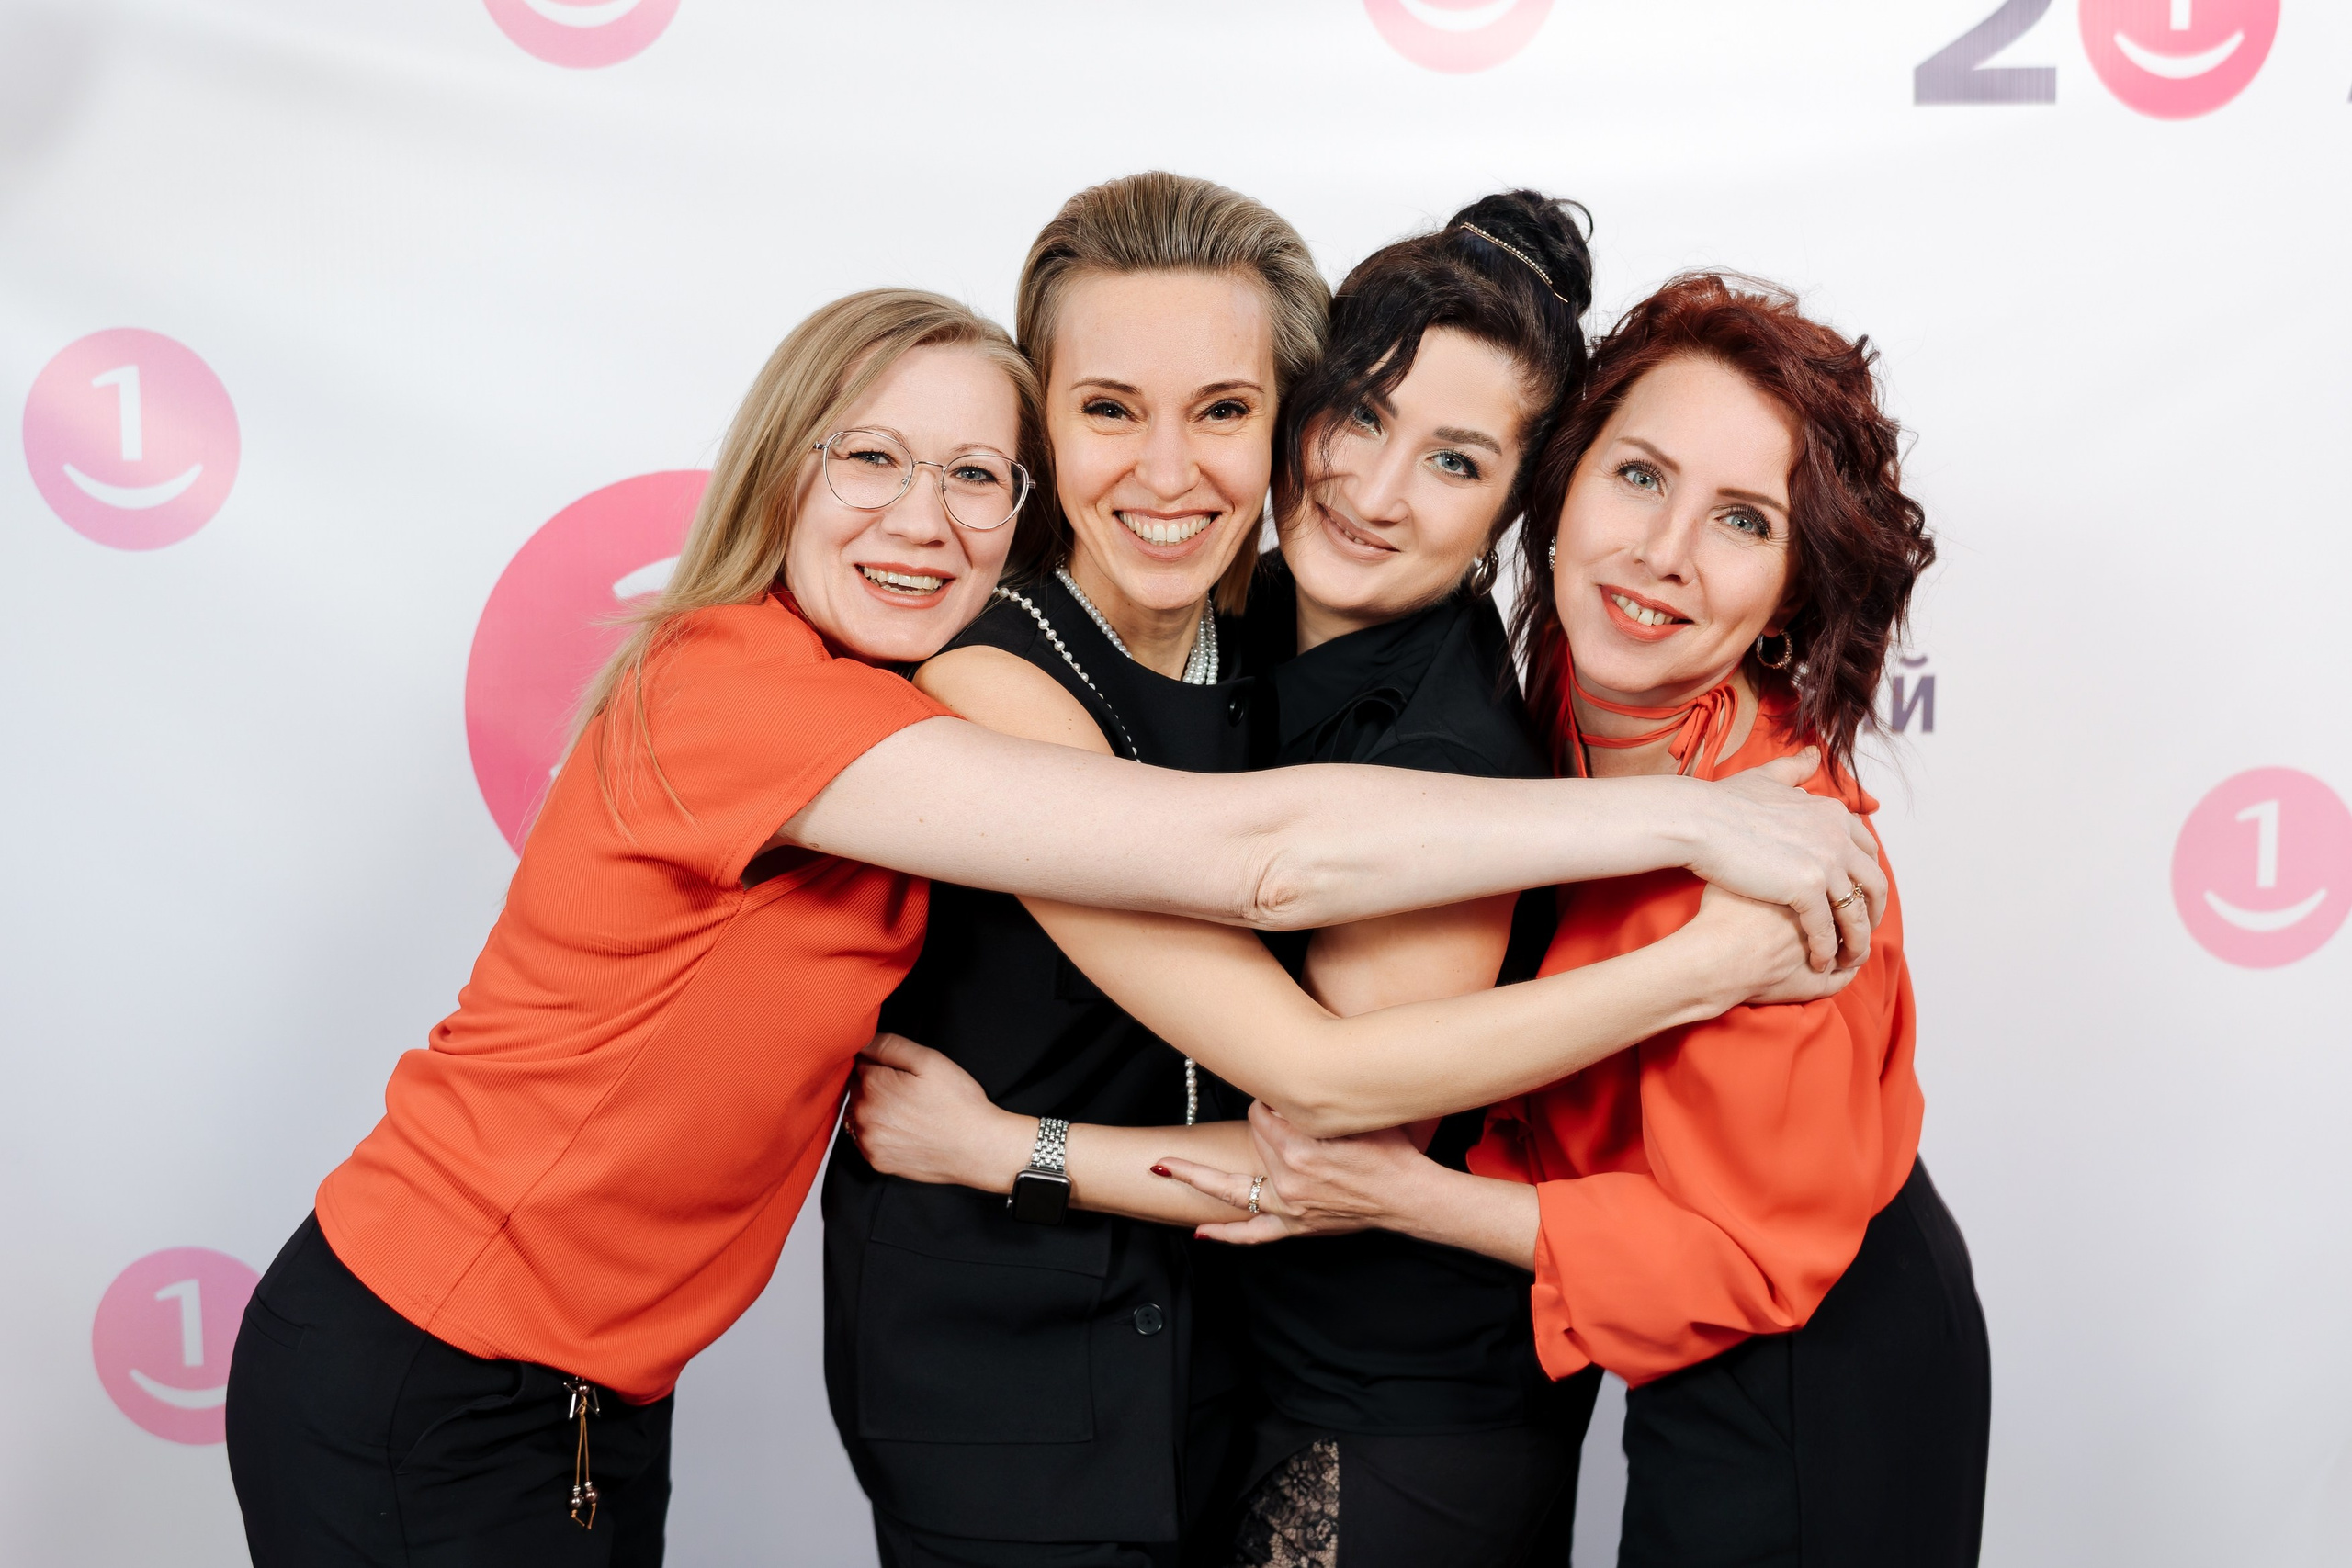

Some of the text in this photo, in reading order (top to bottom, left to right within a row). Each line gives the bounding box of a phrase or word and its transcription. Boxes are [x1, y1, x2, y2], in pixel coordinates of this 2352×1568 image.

[91, 364, 142, 461] 1
[2234, 798, 2279, 888] 1
[154, 1278, 204, 1368] 1
